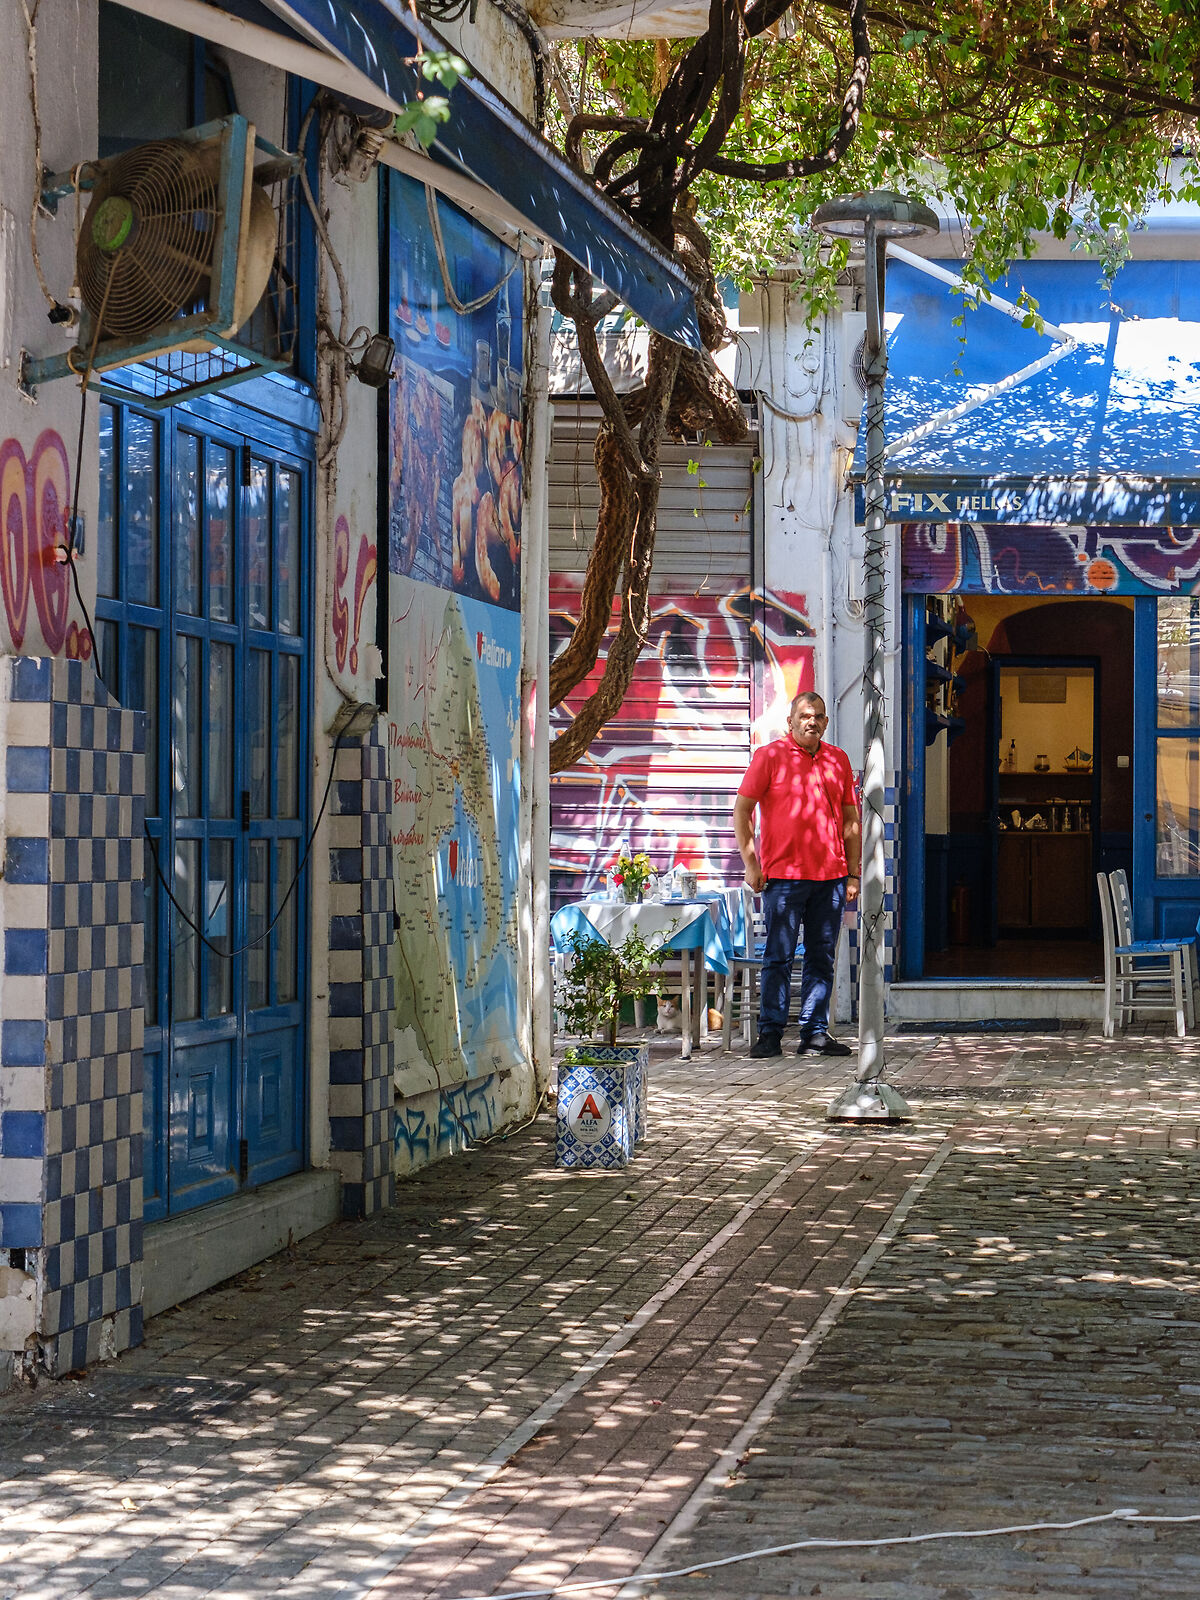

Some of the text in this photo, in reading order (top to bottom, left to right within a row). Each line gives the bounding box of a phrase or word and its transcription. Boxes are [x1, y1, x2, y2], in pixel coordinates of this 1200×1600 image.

[891, 493, 1022, 512] FIX HELLAS
[481, 635, 506, 669] Pelion
